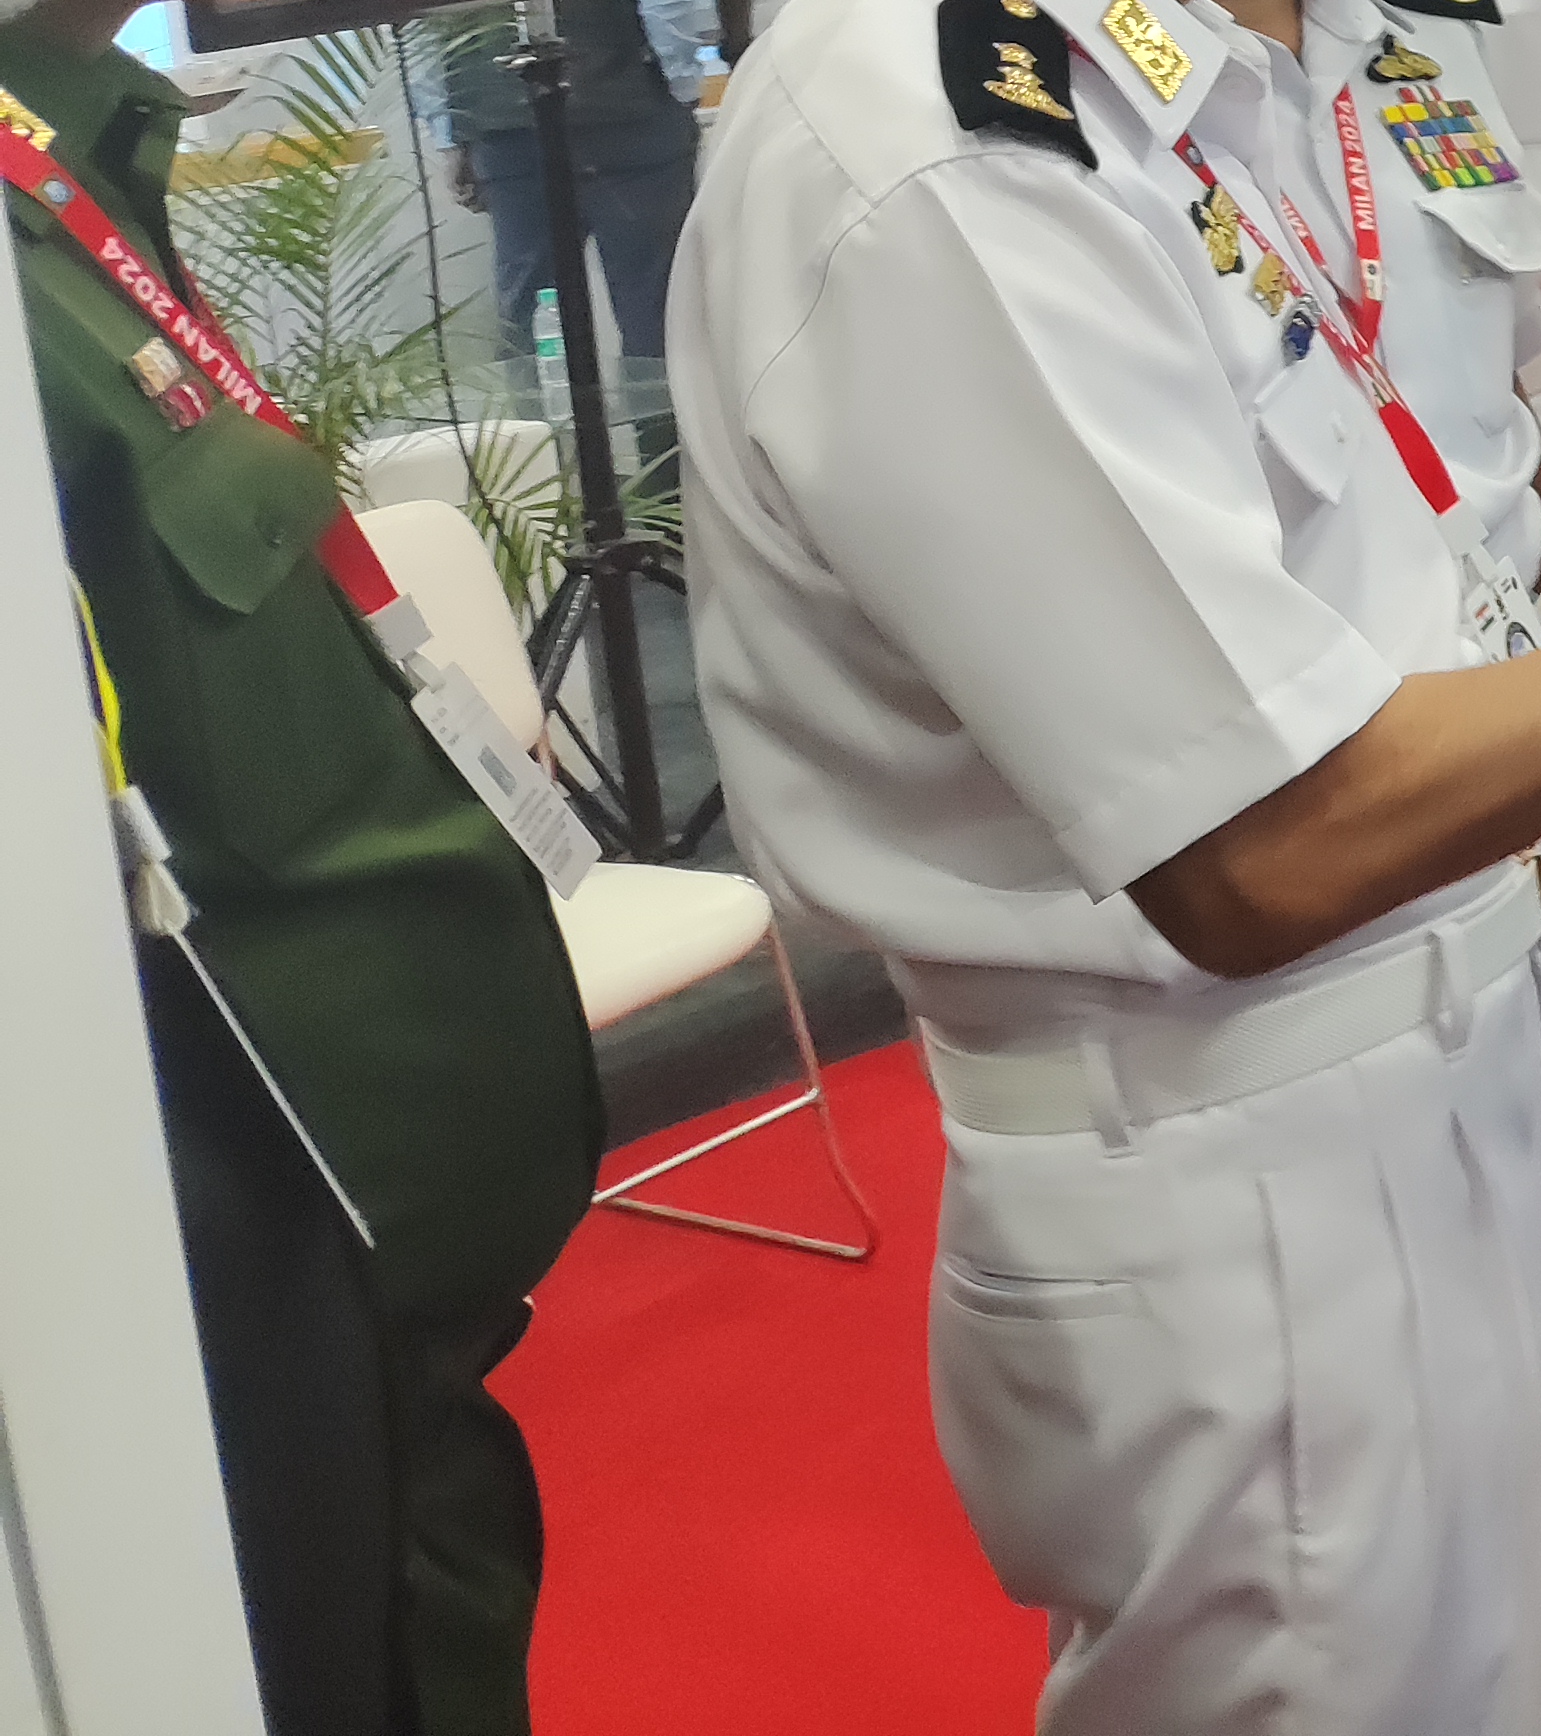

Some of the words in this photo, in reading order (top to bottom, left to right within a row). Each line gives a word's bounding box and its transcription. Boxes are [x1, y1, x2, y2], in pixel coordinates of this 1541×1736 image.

[1336, 100, 1364, 157] 2024
[1347, 157, 1376, 232] MILAN
[101, 236, 175, 320] 2024
[172, 314, 262, 415] MILAN
